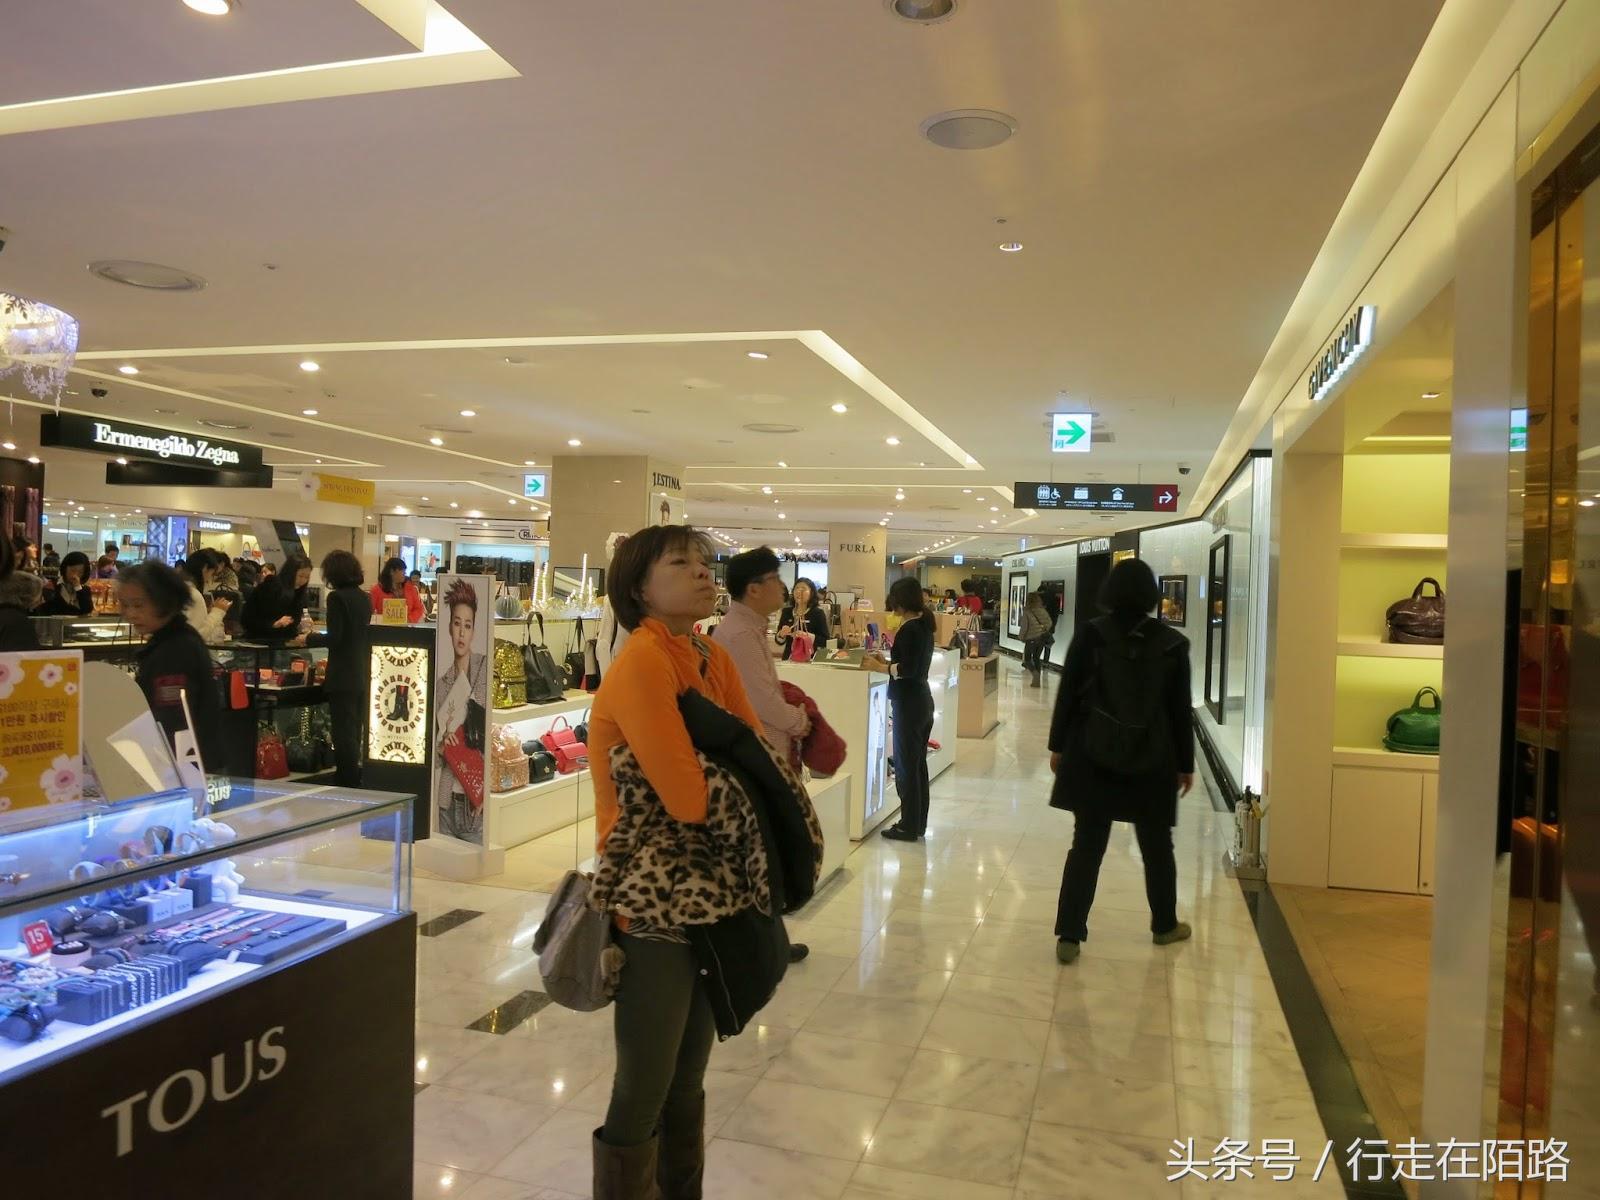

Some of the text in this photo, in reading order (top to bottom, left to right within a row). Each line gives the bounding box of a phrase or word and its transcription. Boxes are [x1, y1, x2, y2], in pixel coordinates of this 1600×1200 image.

[94, 423, 240, 465] Ermenegildo Zegna
[839, 543, 876, 554] FURLA
[386, 607, 404, 619] SALE
[101, 1026, 287, 1157] TOUS
